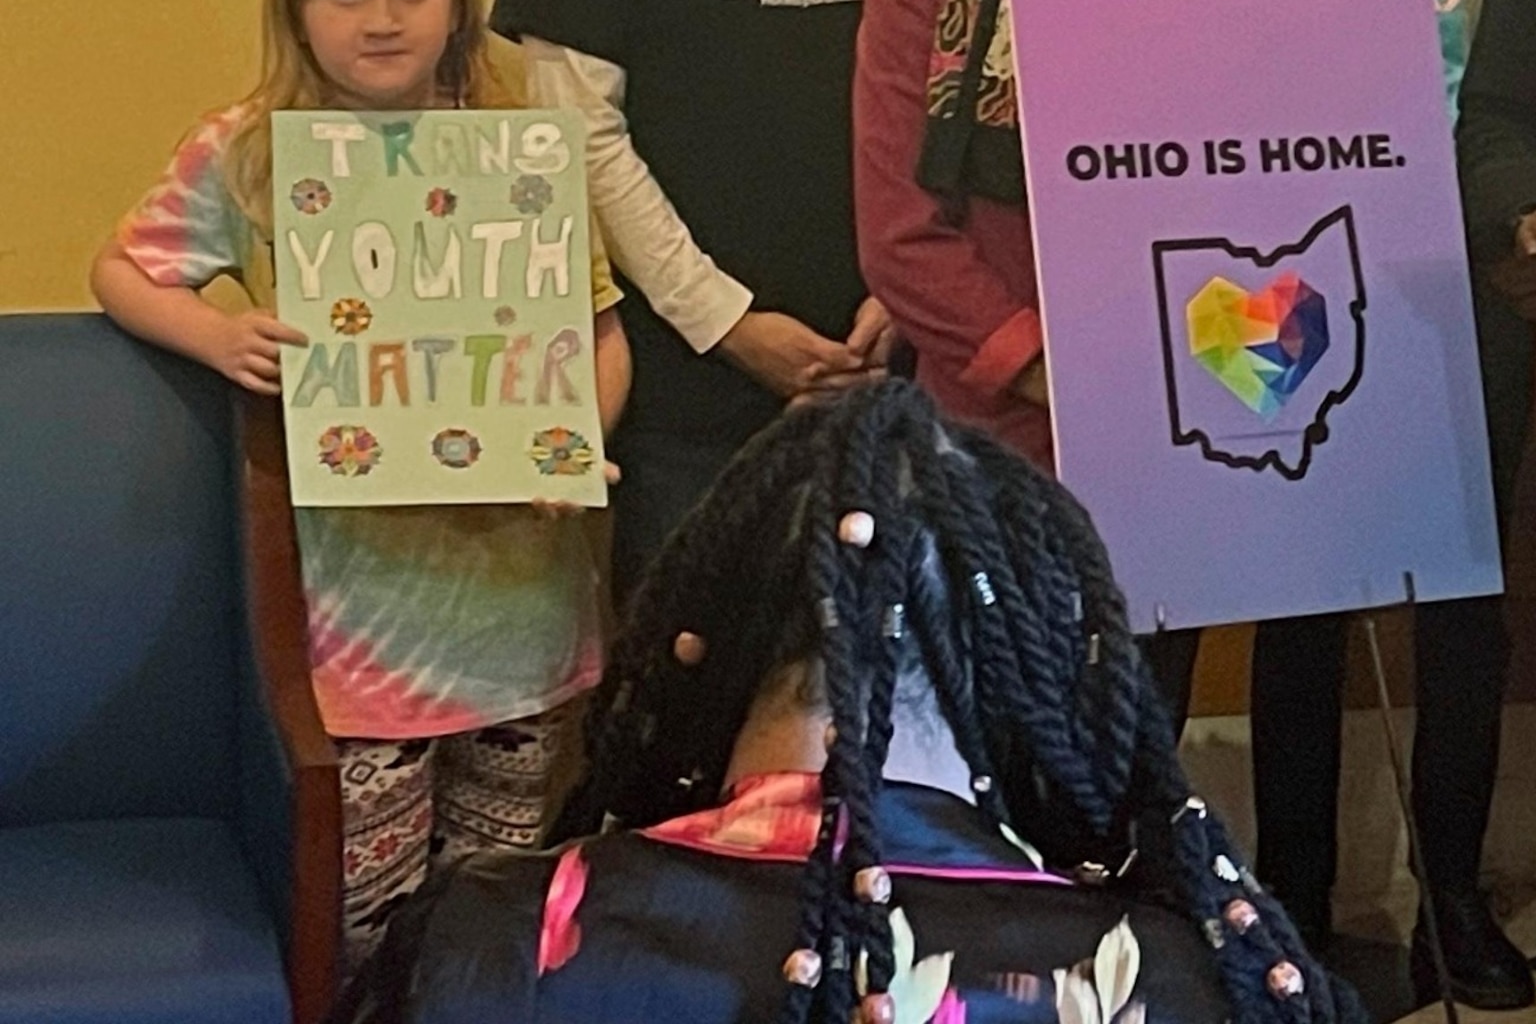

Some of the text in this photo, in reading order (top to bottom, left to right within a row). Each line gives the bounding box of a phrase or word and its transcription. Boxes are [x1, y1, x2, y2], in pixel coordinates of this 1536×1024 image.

[311, 119, 571, 177] TRANS
[1066, 134, 1406, 181] OHIO IS HOME.
[288, 215, 573, 300] YOUTH
[289, 328, 584, 407] MATTER
